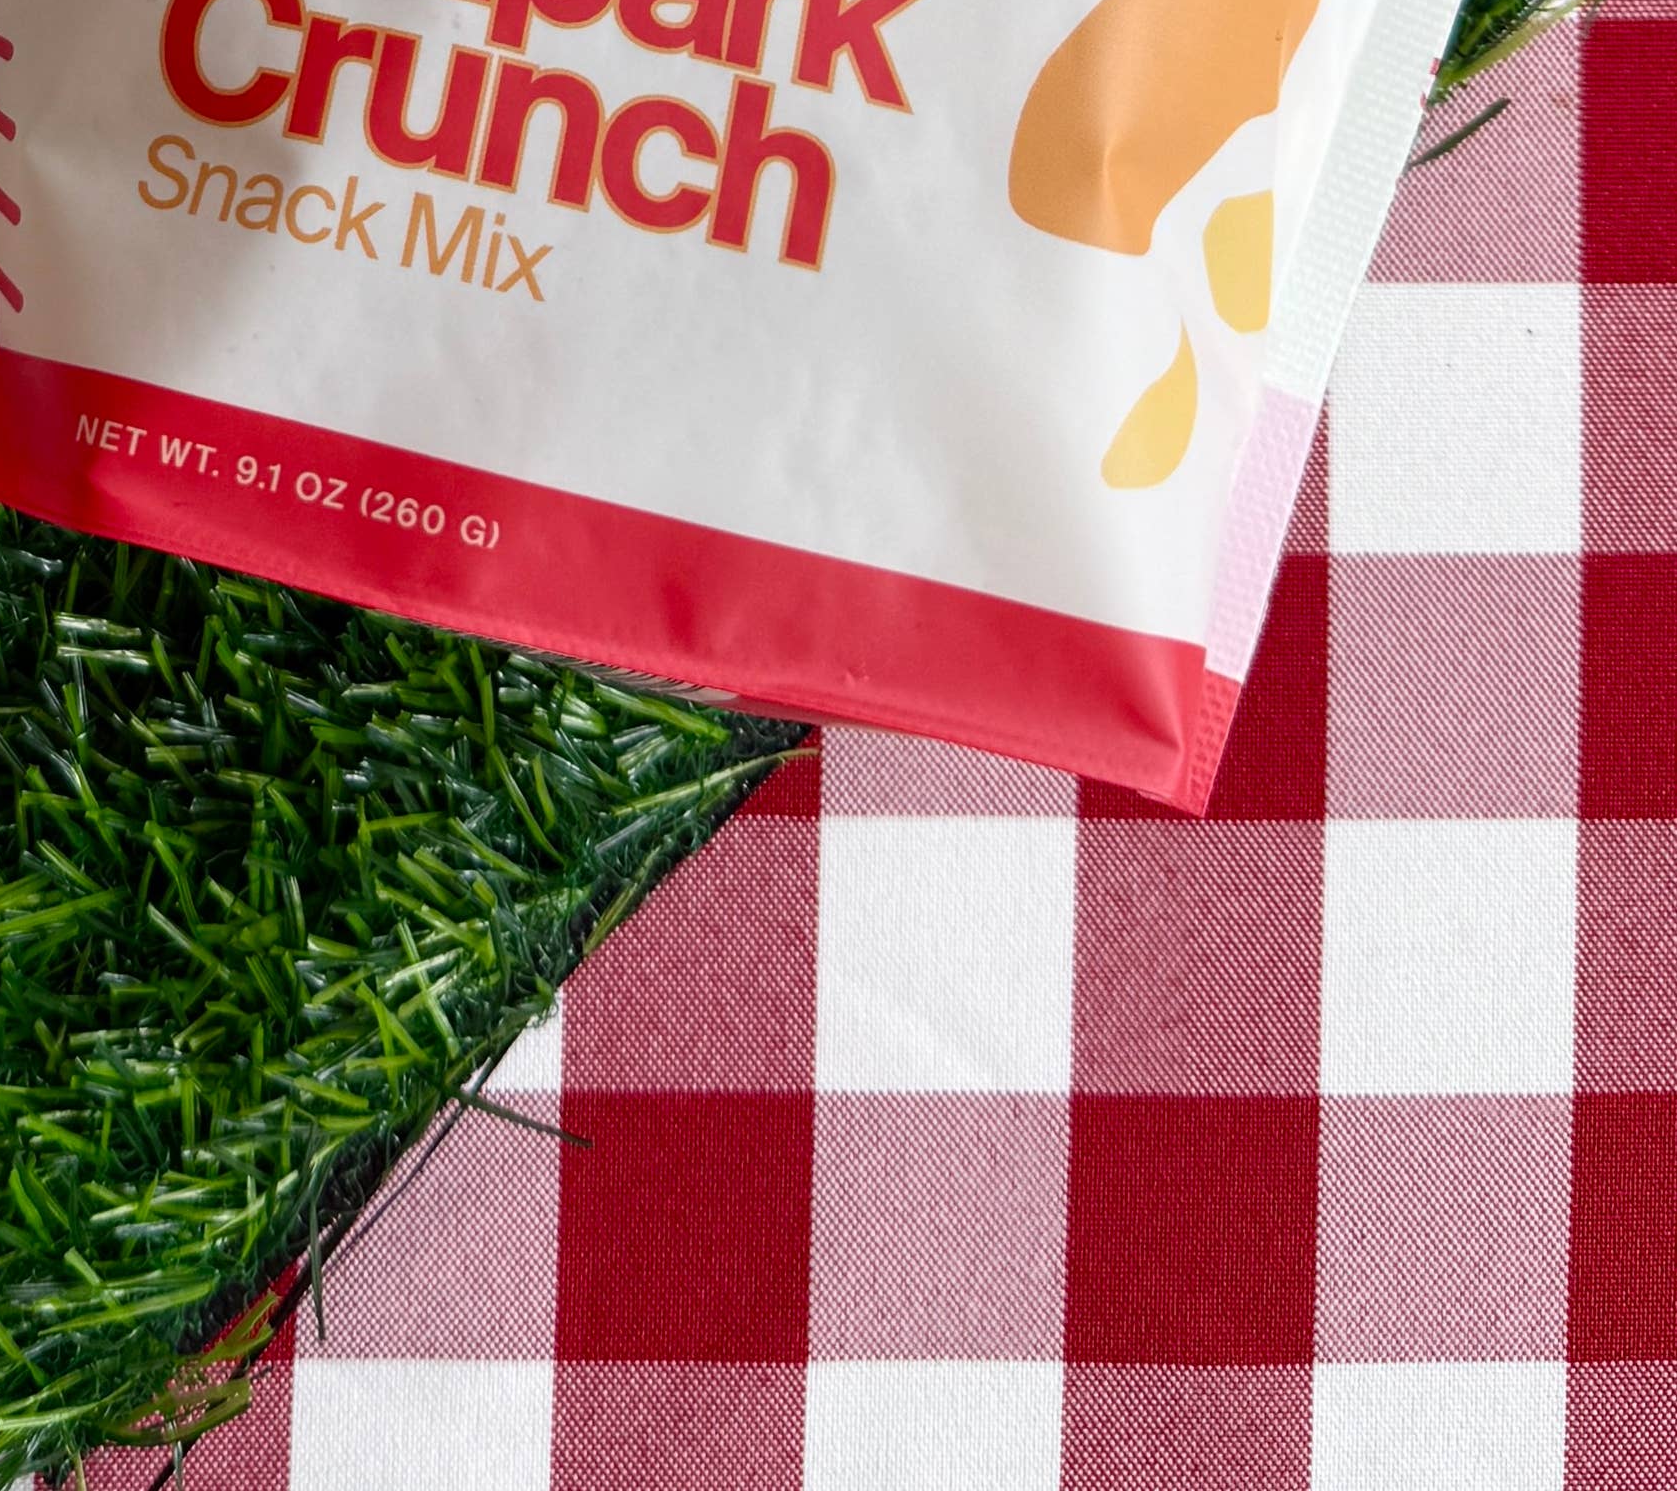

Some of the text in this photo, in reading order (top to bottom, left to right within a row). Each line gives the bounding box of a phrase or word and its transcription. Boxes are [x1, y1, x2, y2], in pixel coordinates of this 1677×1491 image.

[137, 132, 555, 302] Snack Mix
[76, 414, 500, 550] NET WT. 9.1 OZ (260 G)
